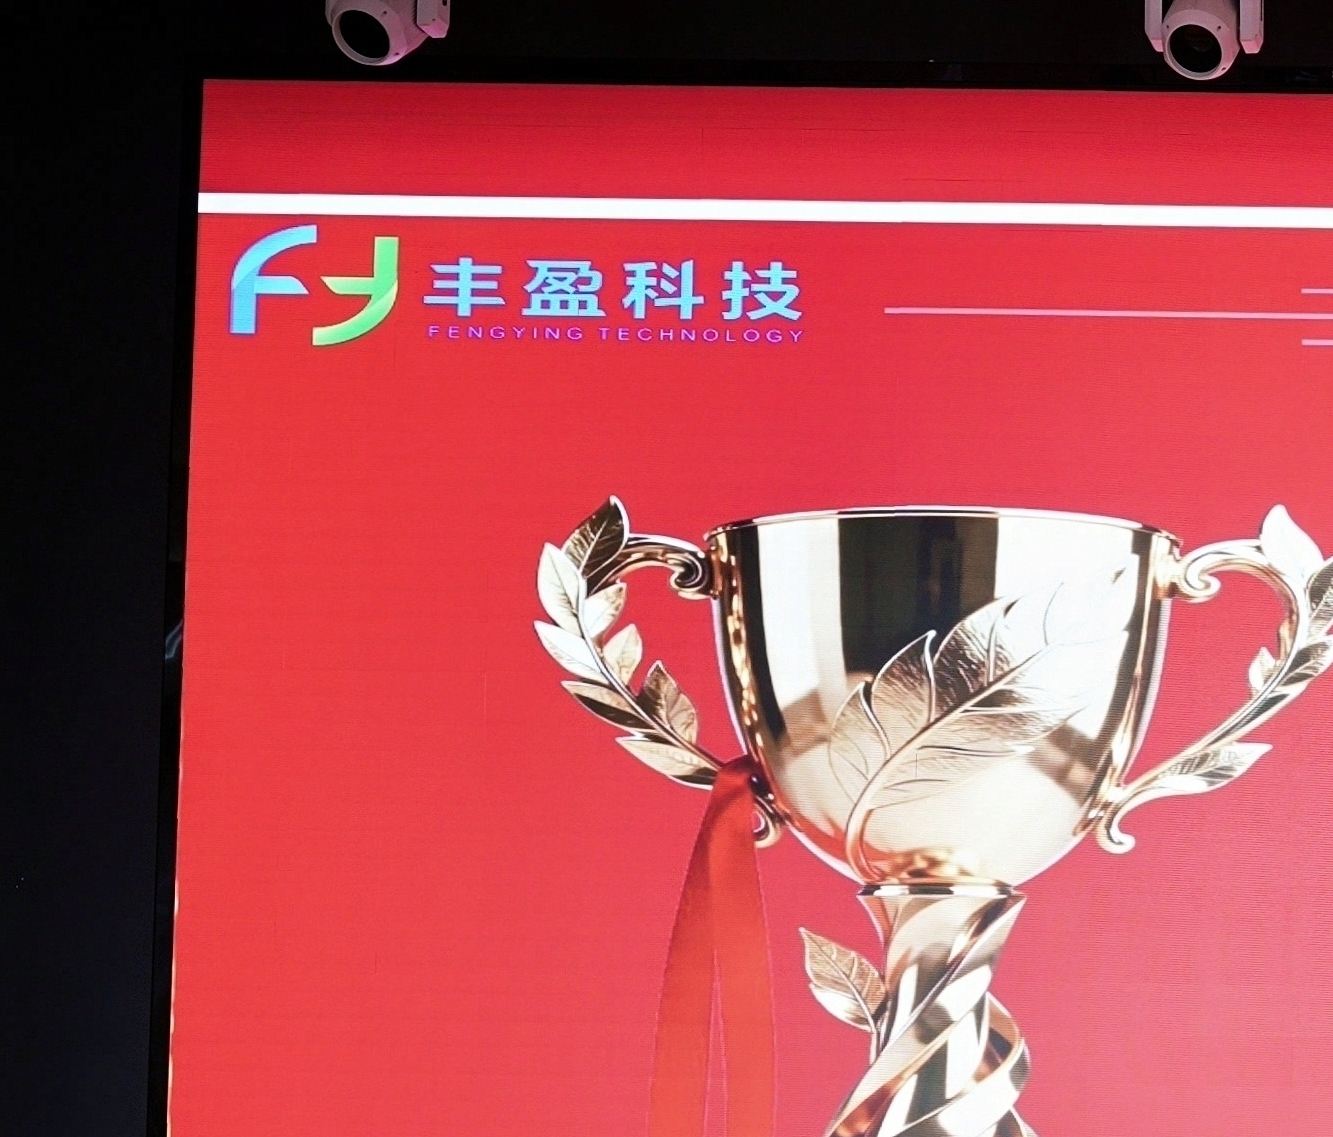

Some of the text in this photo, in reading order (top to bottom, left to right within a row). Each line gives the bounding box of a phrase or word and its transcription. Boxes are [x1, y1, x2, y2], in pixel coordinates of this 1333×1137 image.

[422, 256, 804, 322] 丰盈科技
[428, 325, 804, 345] FENGYING TECHNOLOGY
